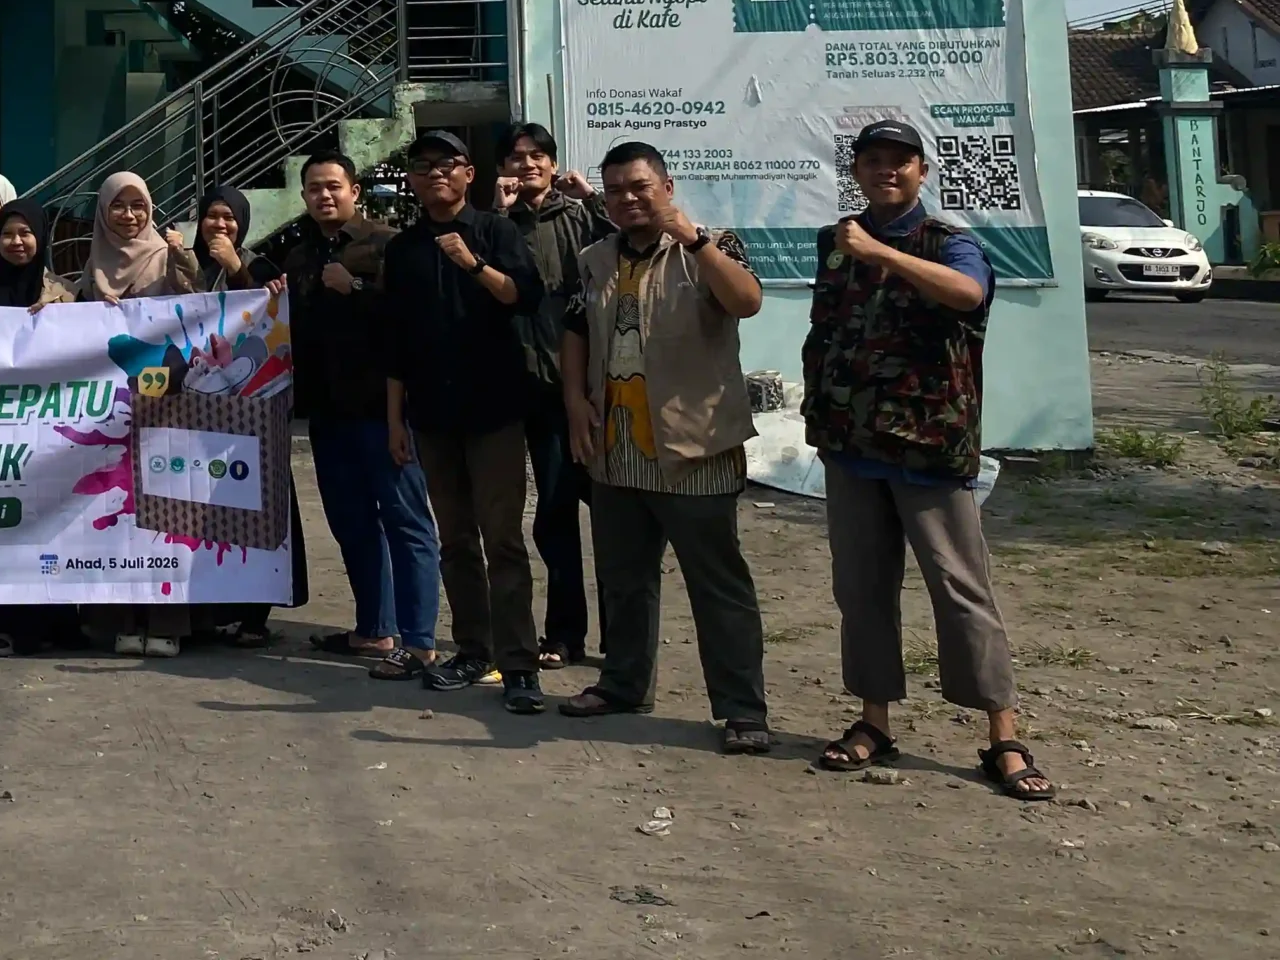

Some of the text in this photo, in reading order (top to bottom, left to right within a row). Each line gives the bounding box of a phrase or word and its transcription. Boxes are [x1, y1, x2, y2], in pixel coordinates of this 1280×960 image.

[612, 8, 681, 30] di Kafe
[825, 40, 1001, 52] DANA TOTAL YANG DIBUTUHKAN
[825, 50, 983, 66] RP5.803.200.000
[825, 69, 945, 78] Tanah Seluas 2.232 m2
[586, 88, 683, 98] Info Donasi Wakaf
[586, 101, 726, 116] 0815-4620-0942
[933, 105, 1012, 114] SCAN PROPOSAL
[587, 118, 707, 130] Bapak Agung Prastyo
[683, 149, 701, 158] 133
[704, 149, 733, 158] 2003
[682, 161, 731, 170] SYARIAH
[733, 160, 762, 170] 8062
[764, 160, 796, 170] 11000
[799, 160, 820, 170] 770
[721, 172, 786, 182] Muhammadiyah
[787, 172, 818, 181] Ngaglik
[1190, 120, 1206, 225] BANTARJO
[65, 556, 179, 572] Ahad, 5 Juli 2026
